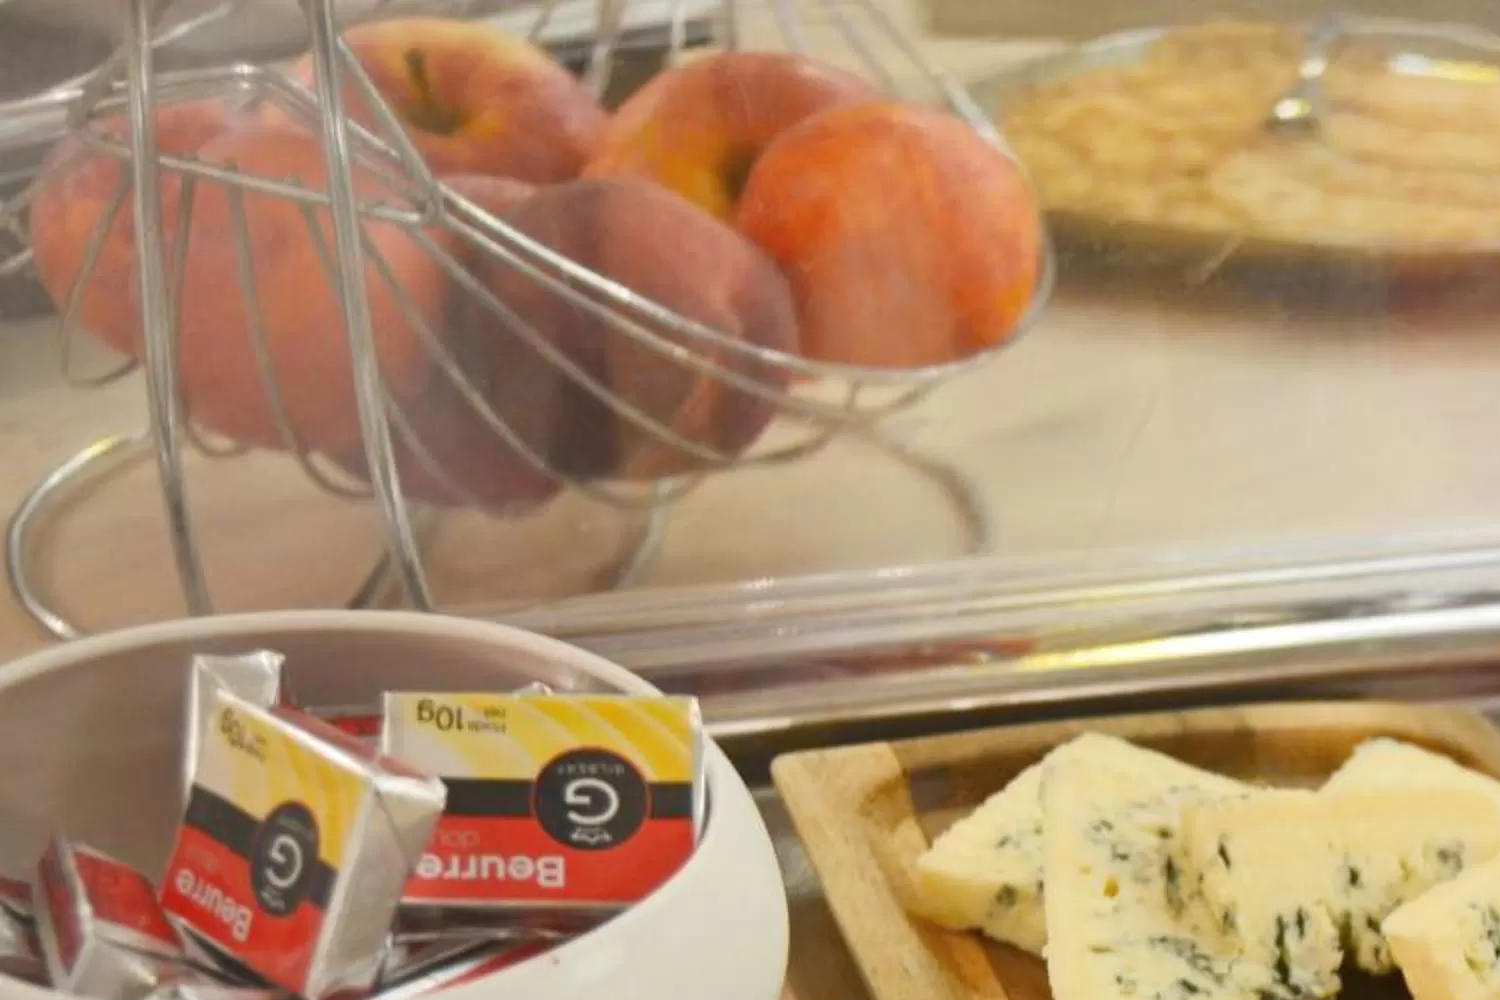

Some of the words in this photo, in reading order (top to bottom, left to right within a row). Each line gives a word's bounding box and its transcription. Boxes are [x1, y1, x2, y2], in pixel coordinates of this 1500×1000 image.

[416, 698, 463, 732] 10g
[564, 777, 620, 825] G
[264, 832, 302, 889] G
[415, 852, 566, 888] Beurre
[175, 868, 252, 942] Beurre
